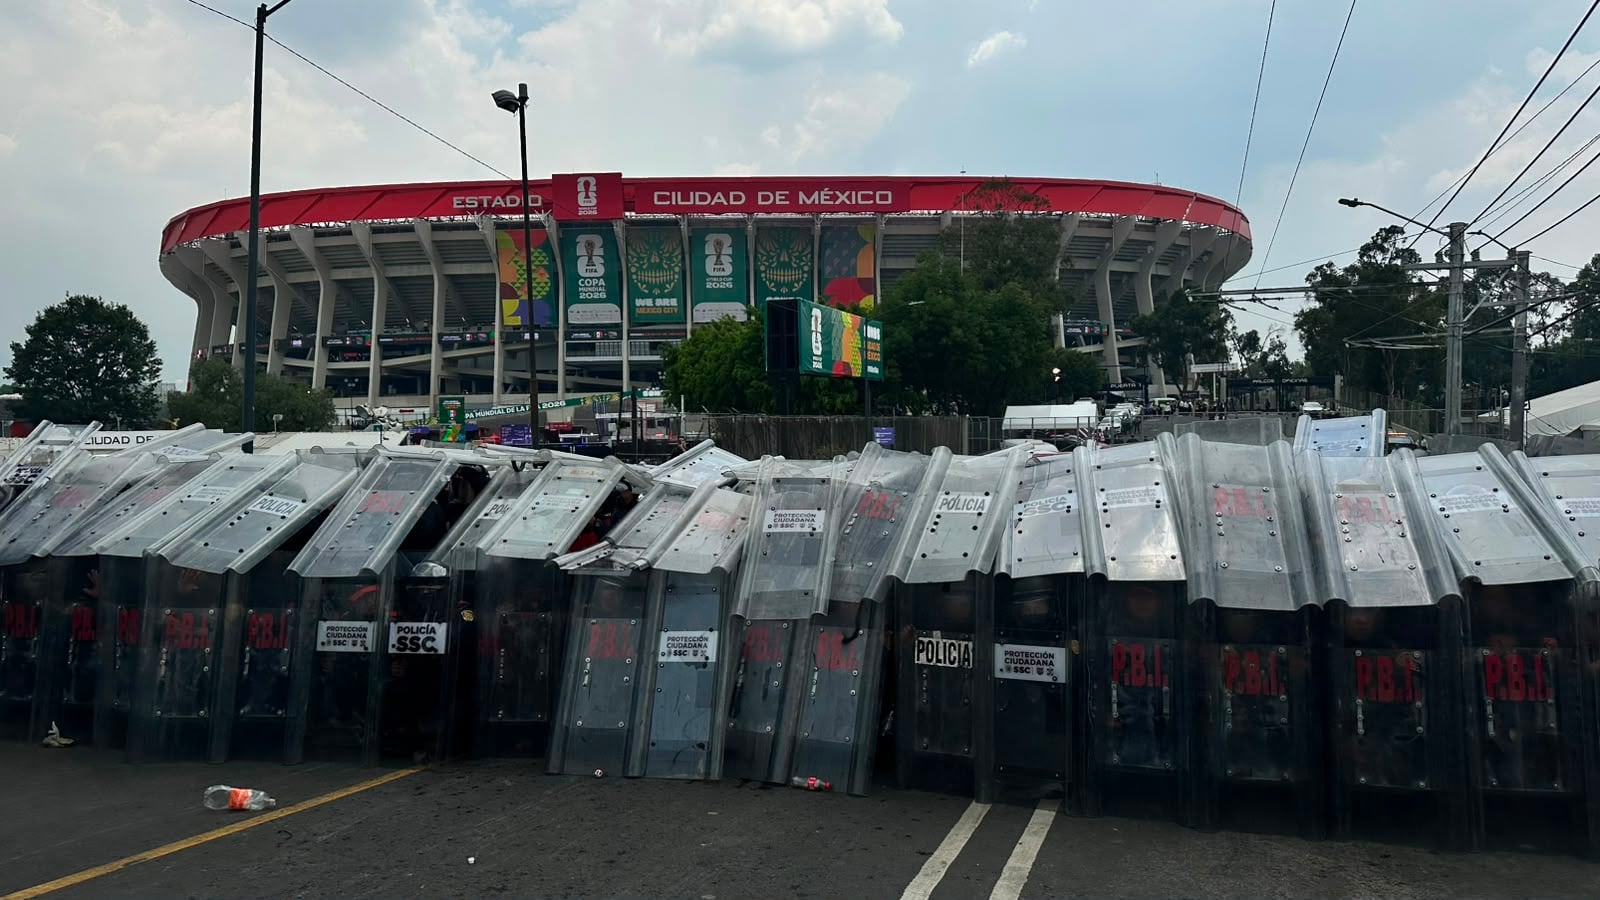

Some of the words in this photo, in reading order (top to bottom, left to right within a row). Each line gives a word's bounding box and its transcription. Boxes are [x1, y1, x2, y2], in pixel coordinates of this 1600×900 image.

[453, 195, 542, 209] ESTADO
[653, 191, 746, 206] CIUDAD
[757, 191, 789, 205] DE
[798, 188, 893, 205] MÉXICO
[578, 279, 605, 287] COPA
[635, 298, 654, 307] WE
[655, 298, 678, 307] ARE
[475, 405, 506, 417] MUNDIAL
[506, 403, 516, 412] DE
[516, 402, 526, 411] LA
[542, 400, 567, 409] 2026
[252, 498, 298, 515] POLICIA
[938, 498, 985, 512] POLICIA
[1023, 501, 1067, 517] SSC
[326, 625, 369, 633] PROTECCIÓN
[396, 624, 437, 635] POLICÍA
[396, 635, 438, 653] SSC
[667, 634, 709, 642] PROTECCIÓN
[916, 639, 971, 667] POLICIA
[1004, 650, 1055, 659] PROTECCIÓN
[1004, 657, 1055, 667] CIUDADANA
[1112, 642, 1169, 688] P.B.I.
[1013, 666, 1031, 674] SSC
[1484, 654, 1553, 702] P.B.I.
